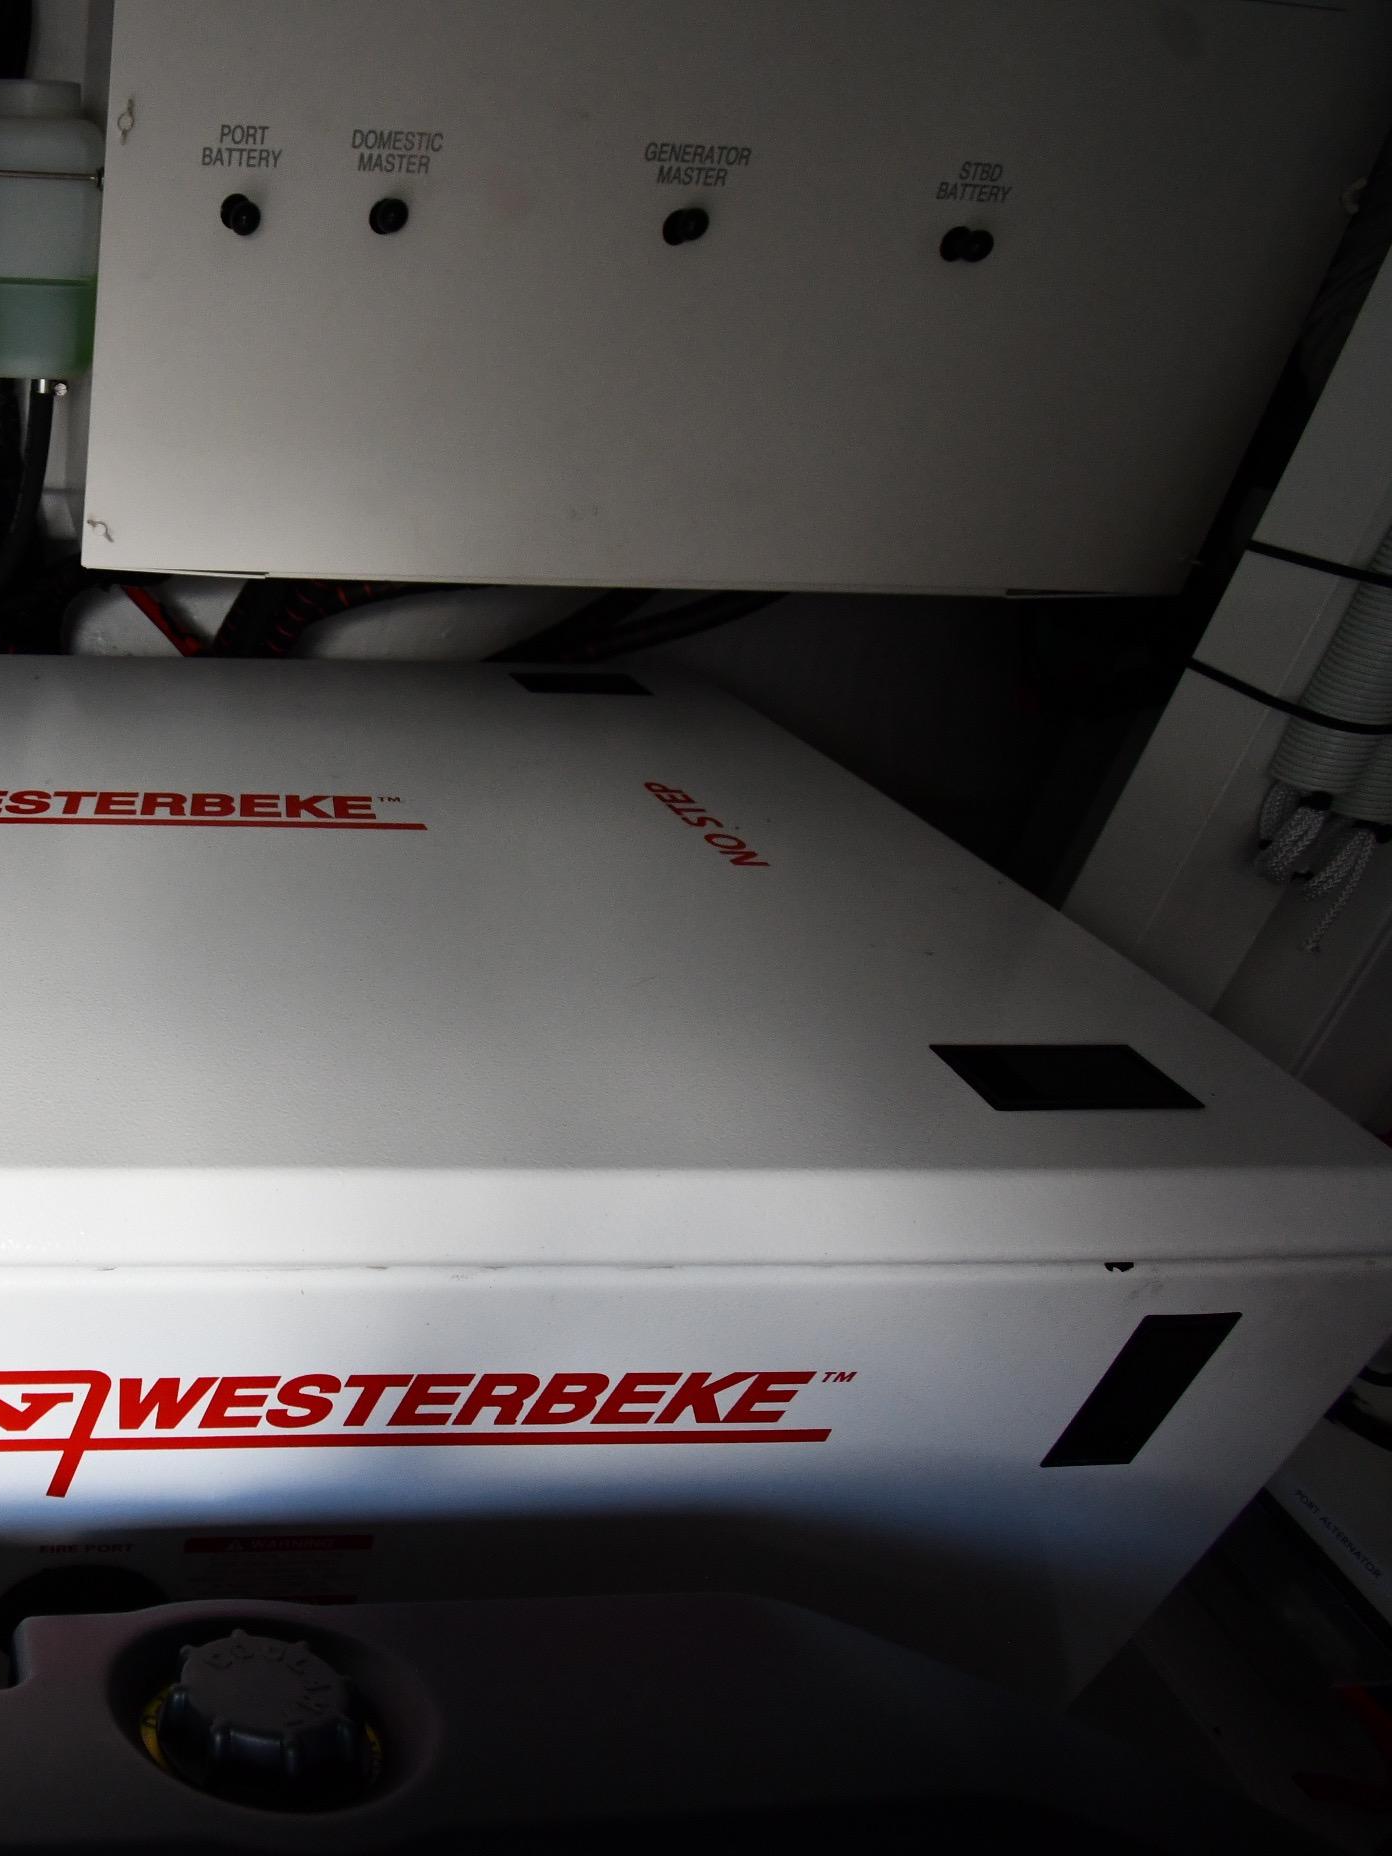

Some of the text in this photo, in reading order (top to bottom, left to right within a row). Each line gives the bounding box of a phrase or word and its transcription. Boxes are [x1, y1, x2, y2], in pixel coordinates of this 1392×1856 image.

[219, 124, 270, 146] PORT
[351, 129, 444, 152] DOMESTIC
[201, 146, 282, 169] BATTERY
[357, 153, 431, 175] MASTER
[644, 142, 752, 166] GENERATOR
[656, 166, 728, 187] MASTER
[958, 161, 1004, 183] STBD
[935, 181, 1012, 204] BATTERY
[644, 782, 770, 867] NO STEP
[116, 1370, 816, 1430] WESTERBEKE
[84, 1544, 135, 1554] PORT
[251, 1538, 338, 1551] WARNING
[1318, 1517, 1383, 1579] ALTERNATOR
